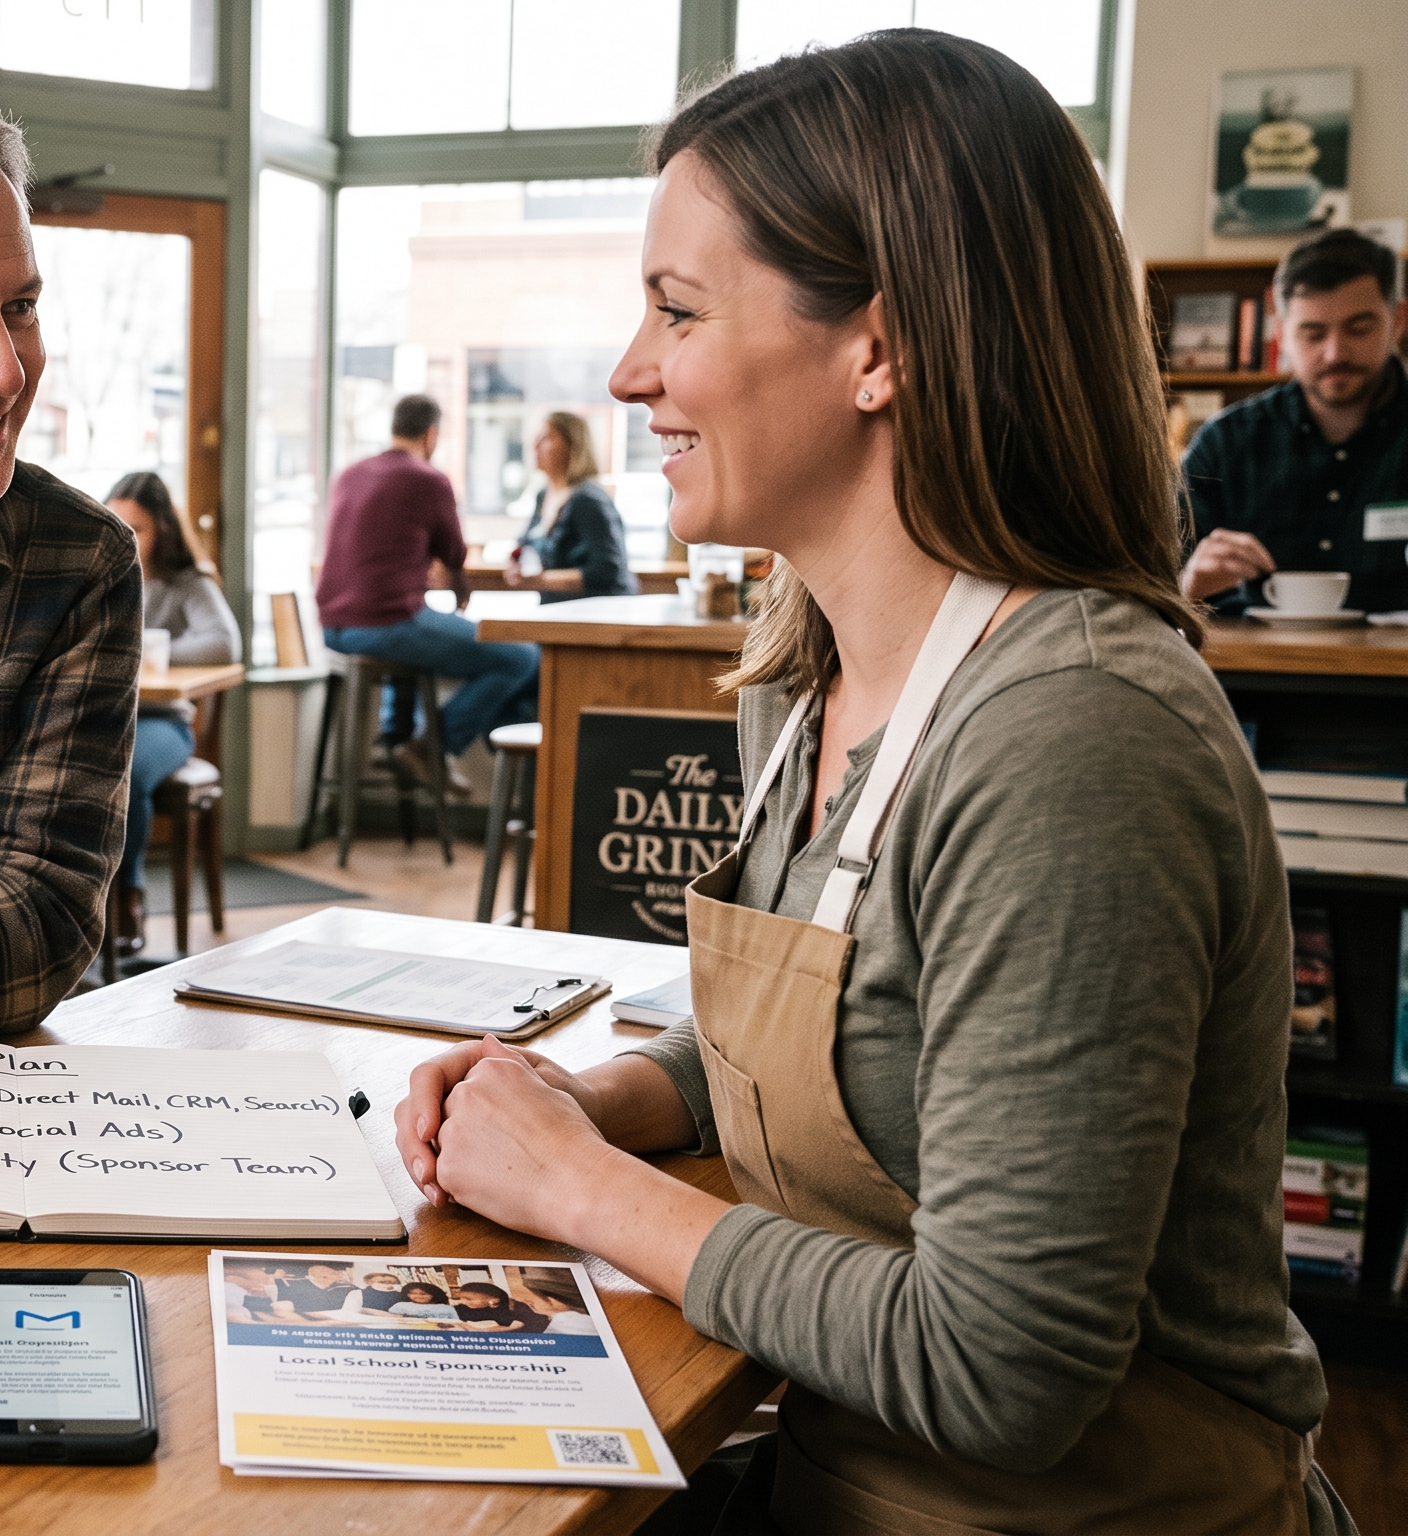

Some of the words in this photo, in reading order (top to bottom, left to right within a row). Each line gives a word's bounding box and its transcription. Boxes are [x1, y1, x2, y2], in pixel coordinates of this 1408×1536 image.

[665, 754, 717, 787] The
[613, 787, 744, 834] DAILY
[93, 1092, 159, 1109] Mail,
[167, 1095, 239, 1112] CRM,
[244, 1096, 339, 1115] Search)
[100, 1122, 182, 1143] Ads)
[60, 1150, 208, 1173] (Sponsor
[221, 1156, 335, 1180] Team)
[279, 1355, 336, 1366] Local
[343, 1357, 419, 1369] School
[424, 1360, 567, 1375] Sponsorship
